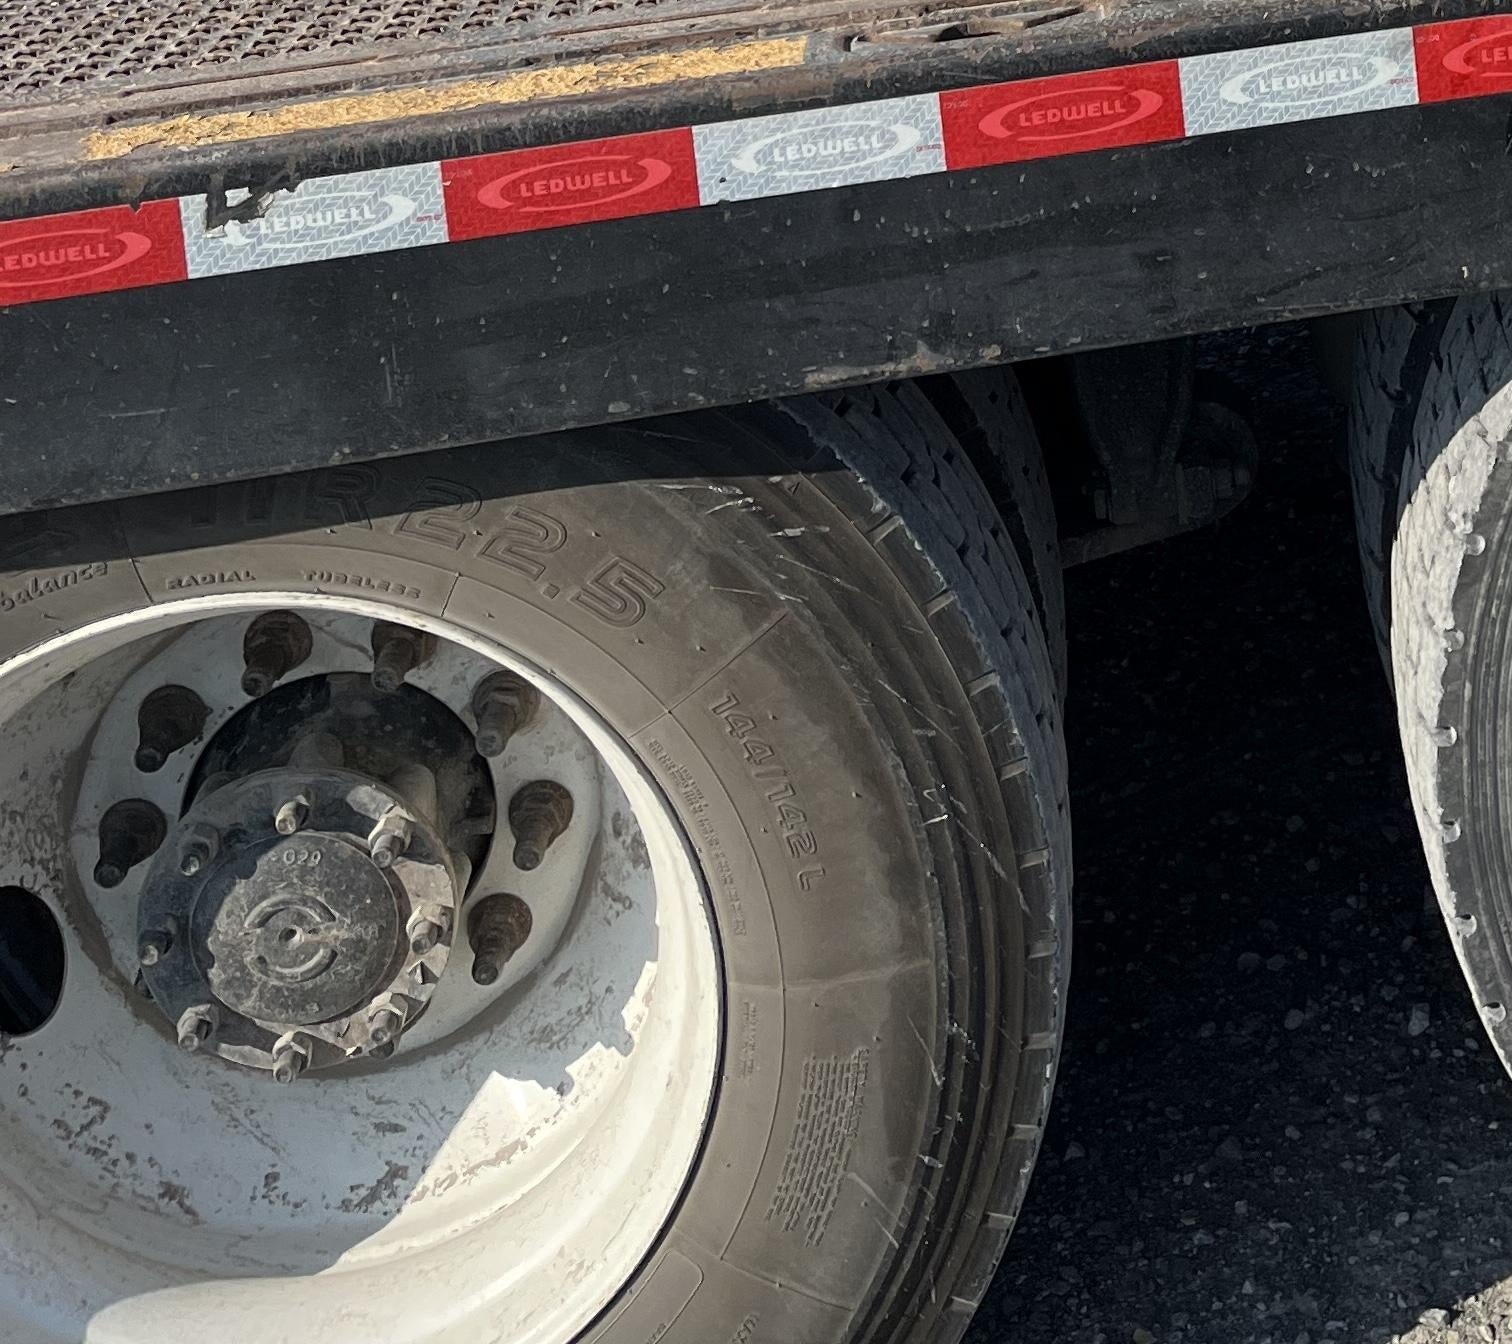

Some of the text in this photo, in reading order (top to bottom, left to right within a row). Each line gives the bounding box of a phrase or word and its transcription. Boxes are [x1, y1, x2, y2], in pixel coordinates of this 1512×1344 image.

[1257, 66, 1364, 97] LEDWELL
[1018, 97, 1128, 129] LEDWELL
[773, 132, 885, 164] LEDWELL
[519, 168, 634, 200] LEDWELL
[259, 205, 377, 235] LEDWELL
[165, 569, 422, 600] RADIAL TUBELESS
[708, 692, 818, 860] 144/142
